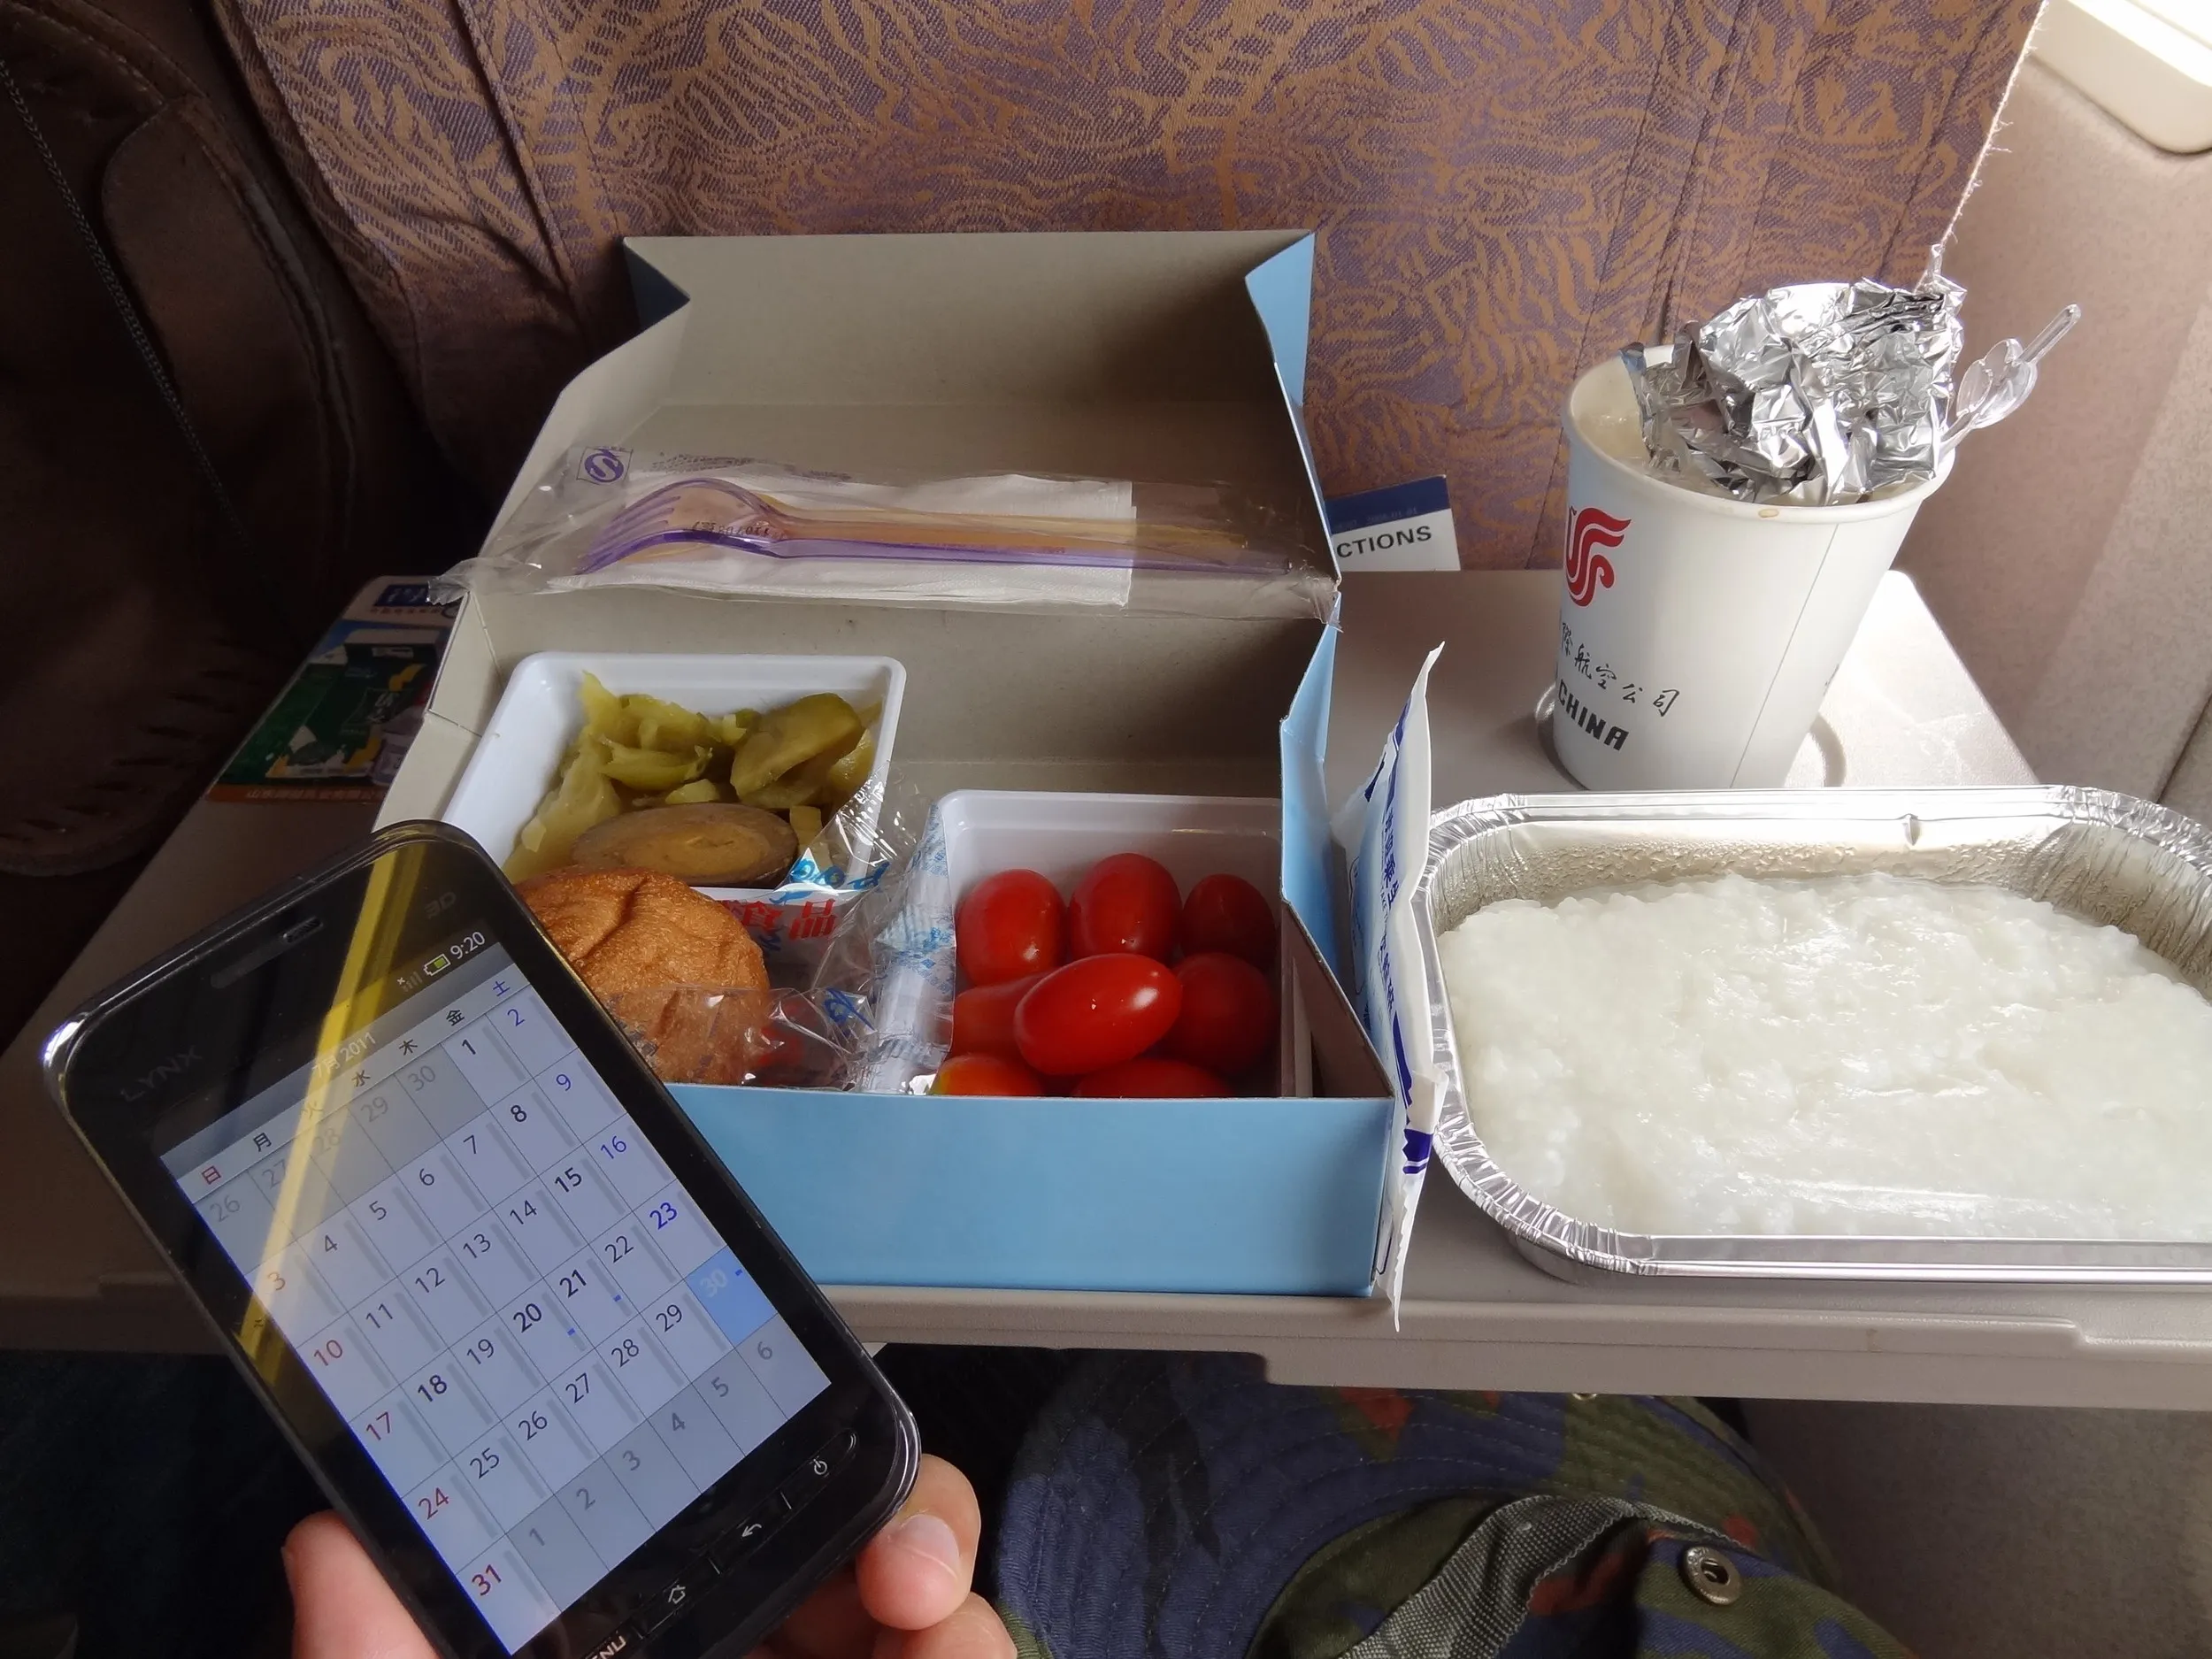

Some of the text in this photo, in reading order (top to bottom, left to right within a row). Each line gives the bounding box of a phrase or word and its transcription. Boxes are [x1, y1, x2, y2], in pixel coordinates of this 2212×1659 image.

[1336, 526, 1432, 558] CTIONS
[1557, 679, 1630, 751] CHINA
[340, 1031, 377, 1062] 2011
[449, 931, 486, 959] 9:20
[119, 1044, 204, 1102] LYNX
[201, 1165, 222, 1186] 日
[253, 1132, 273, 1153] 月
[351, 1070, 371, 1087] 水
[398, 1038, 419, 1056] 木
[445, 1009, 465, 1026] 金
[492, 979, 511, 997] 土
[209, 1194, 241, 1223] 26
[262, 1158, 287, 1189] 27
[360, 1095, 388, 1123] 29
[407, 1064, 436, 1092] 30
[461, 1039, 477, 1056] 1
[506, 1008, 526, 1026] 2
[267, 1073, 572, 1291] 3 4 5 6 7 8 9
[312, 1135, 627, 1368] 10 11 12 13 14 15 16
[365, 1202, 679, 1441] 17 18 19 20 21 22 23
[418, 1268, 728, 1521] 24 25 26 27 28 29 30
[471, 1340, 773, 1597] 31 1 2 3 4 5 6
